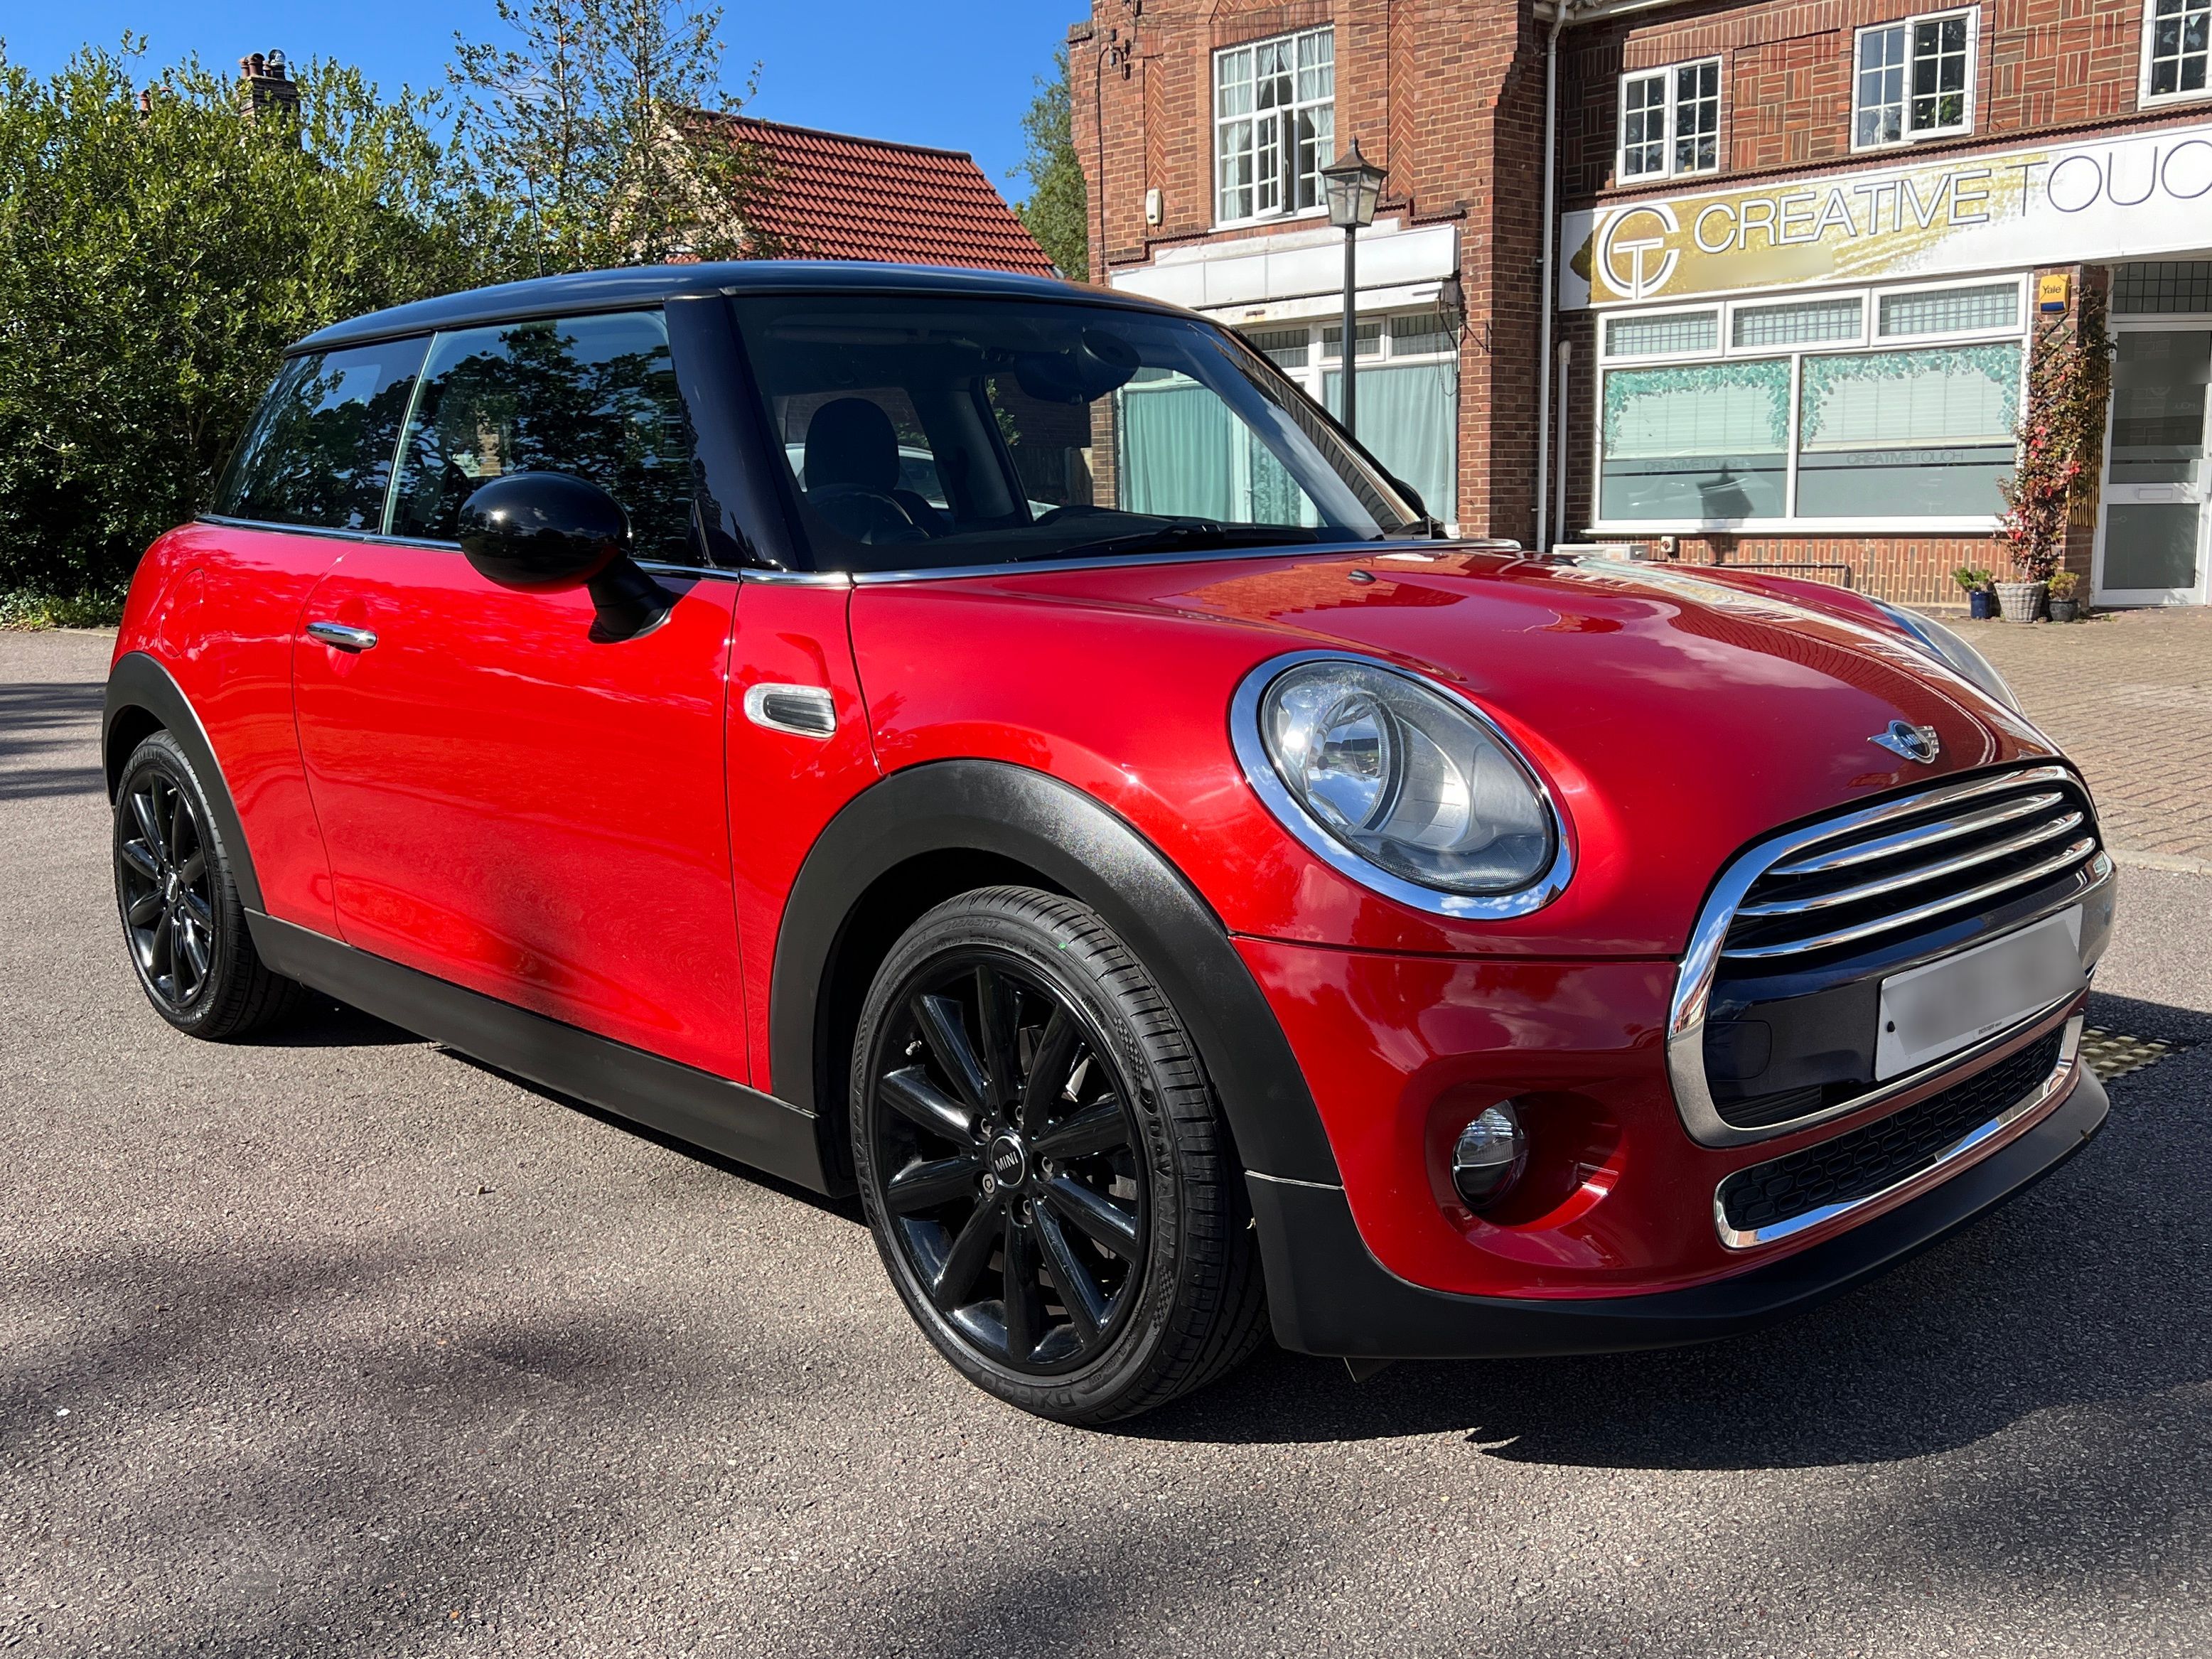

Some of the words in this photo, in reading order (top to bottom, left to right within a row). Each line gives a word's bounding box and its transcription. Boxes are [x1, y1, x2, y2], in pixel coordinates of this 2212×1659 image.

[1693, 168, 1992, 254] CREATIVE
[2004, 139, 2212, 217] TOUC
[2042, 285, 2062, 294] Yale
[1847, 451, 1911, 464] CREATIVE
[1914, 450, 1963, 462] TOUCH
[1644, 458, 1700, 471] CREATIVE
[1901, 733, 1922, 747] MIN
[994, 1151, 1019, 1172] MINI
